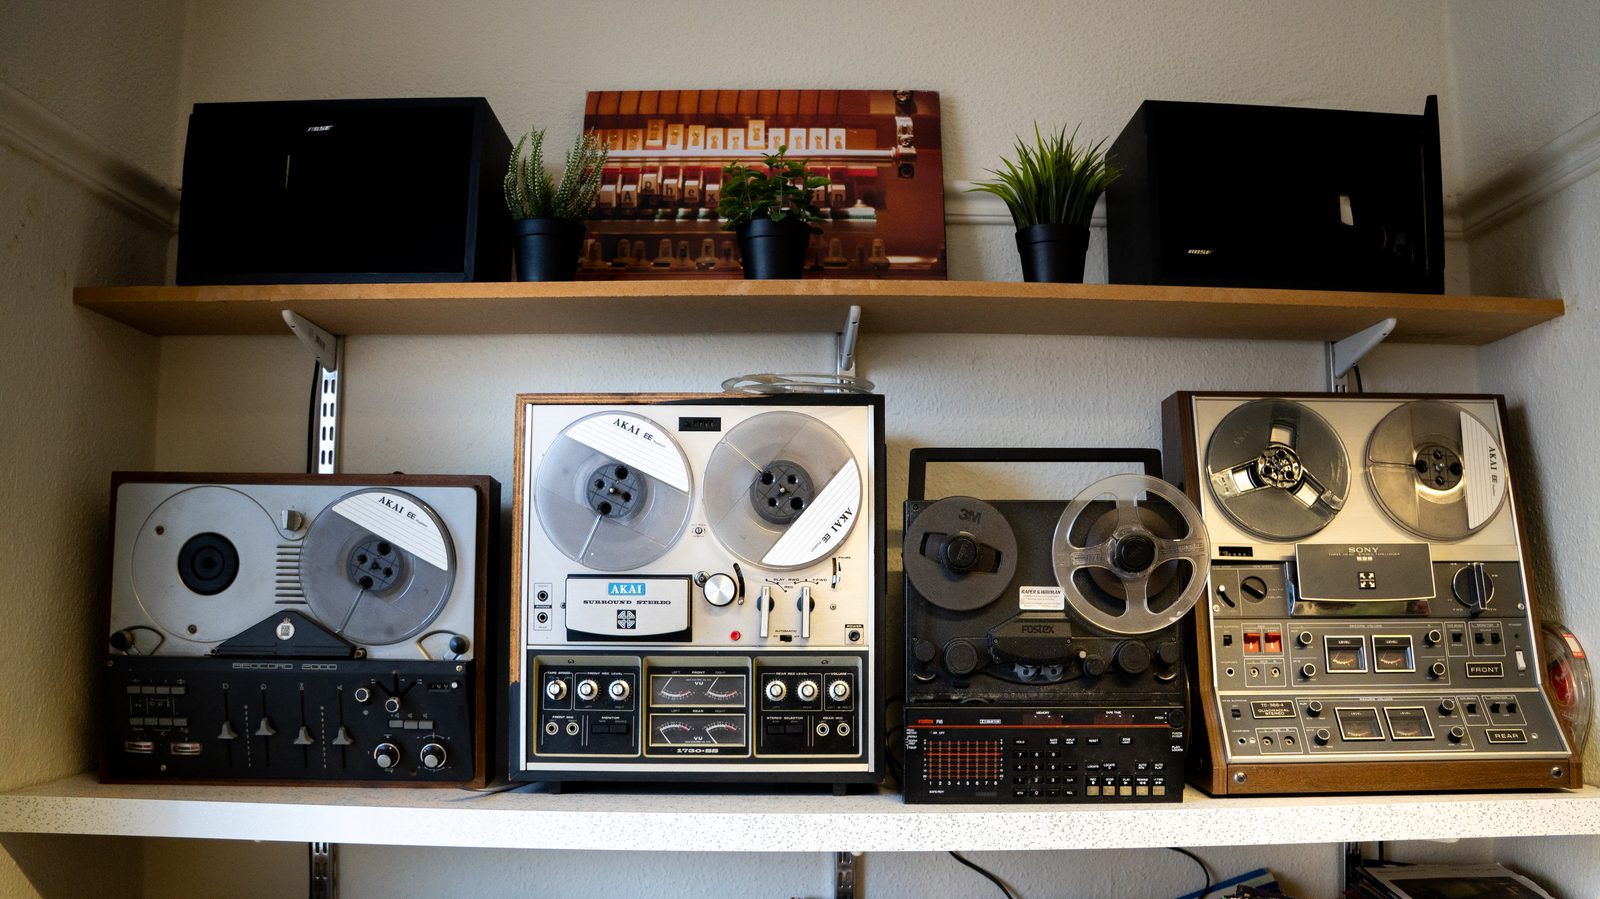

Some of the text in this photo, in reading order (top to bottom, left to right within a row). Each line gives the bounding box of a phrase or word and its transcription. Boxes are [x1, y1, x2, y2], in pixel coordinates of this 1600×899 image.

[613, 418, 640, 435] AKAI
[1489, 446, 1498, 471] AKAI
[378, 496, 405, 514] AKAI
[831, 507, 853, 532] AKAI
[959, 508, 982, 524] 3M
[610, 584, 643, 594] AKAI
